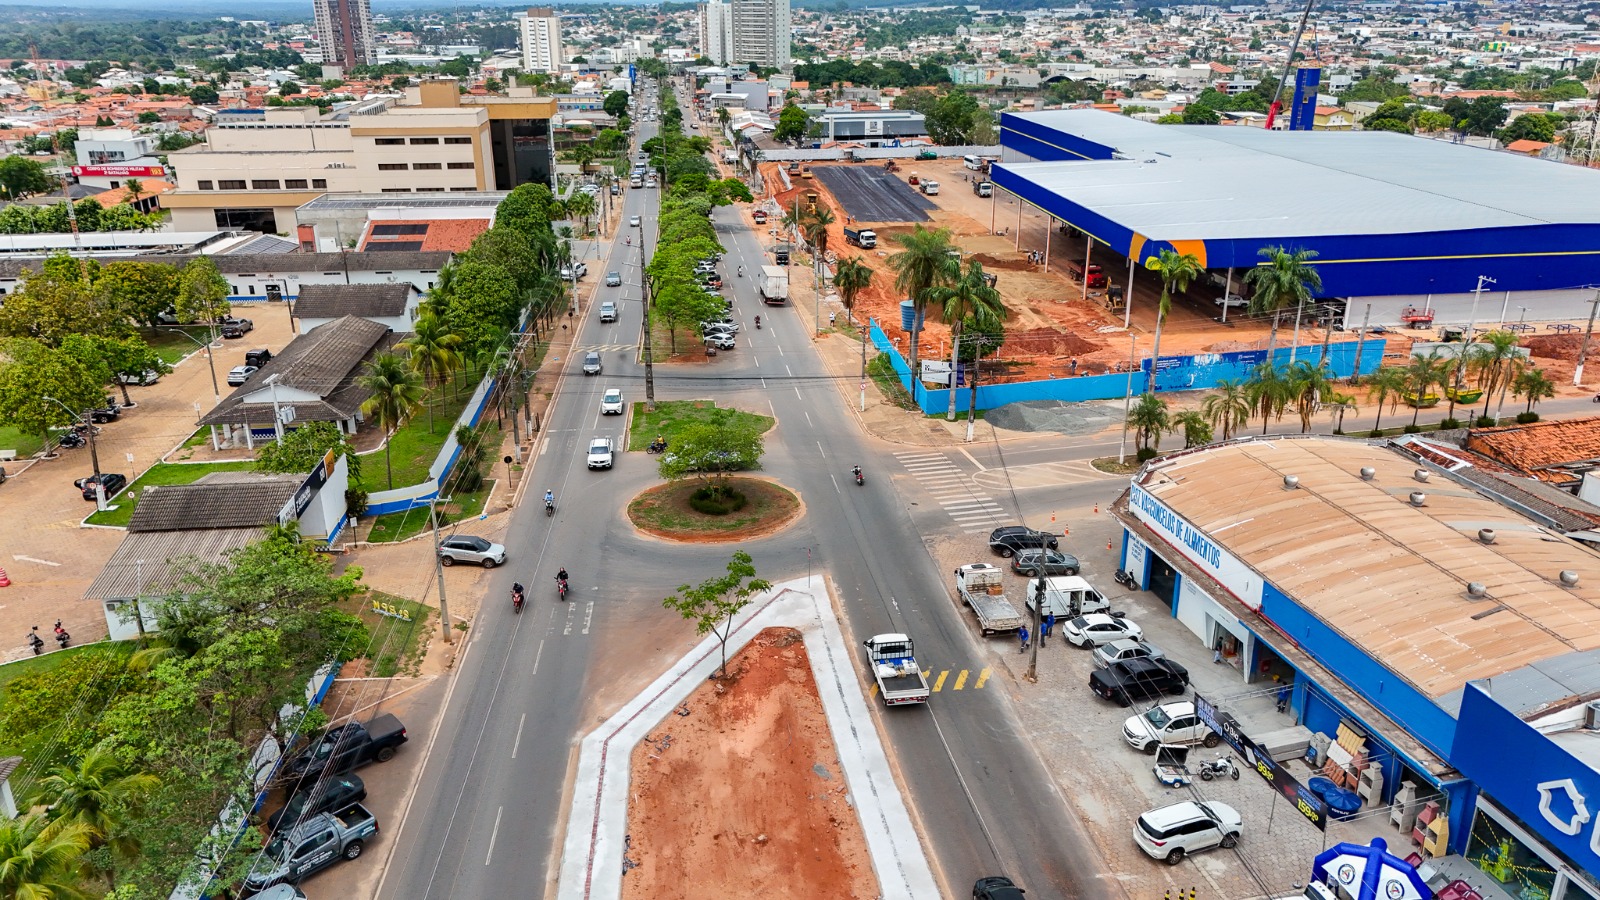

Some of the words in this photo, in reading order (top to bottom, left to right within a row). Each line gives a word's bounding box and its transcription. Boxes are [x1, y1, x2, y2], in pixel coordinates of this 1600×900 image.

[1176, 518, 1184, 541] DE
[1184, 526, 1220, 569] ALIMENTOS
[1197, 697, 1215, 720] BLACK
